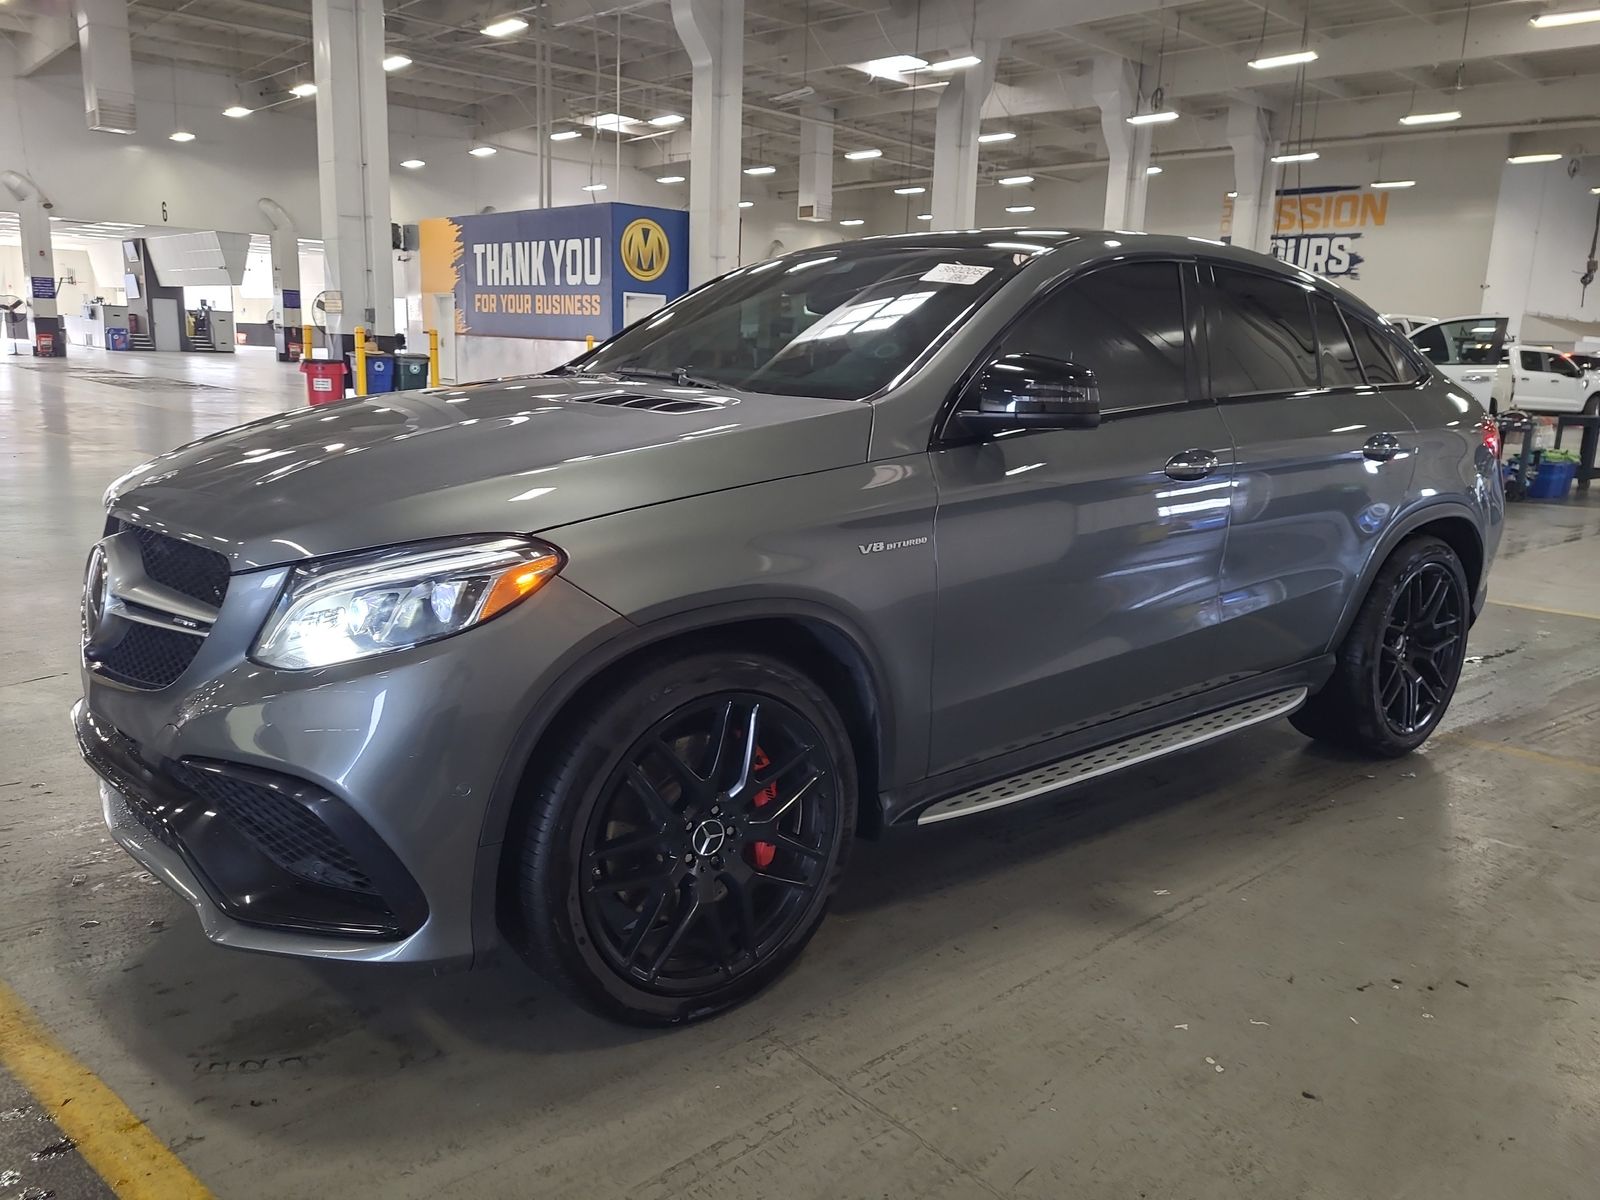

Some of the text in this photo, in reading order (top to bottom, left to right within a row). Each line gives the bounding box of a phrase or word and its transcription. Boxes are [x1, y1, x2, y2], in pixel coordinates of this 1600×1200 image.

[161, 201, 168, 222] 6
[1275, 192, 1389, 230] SSION
[473, 237, 601, 286] THANK YOU
[1271, 237, 1351, 273] OURS
[475, 294, 601, 315] FOR YOUR BUSINESS
[859, 537, 927, 554] V8 BITURBO
